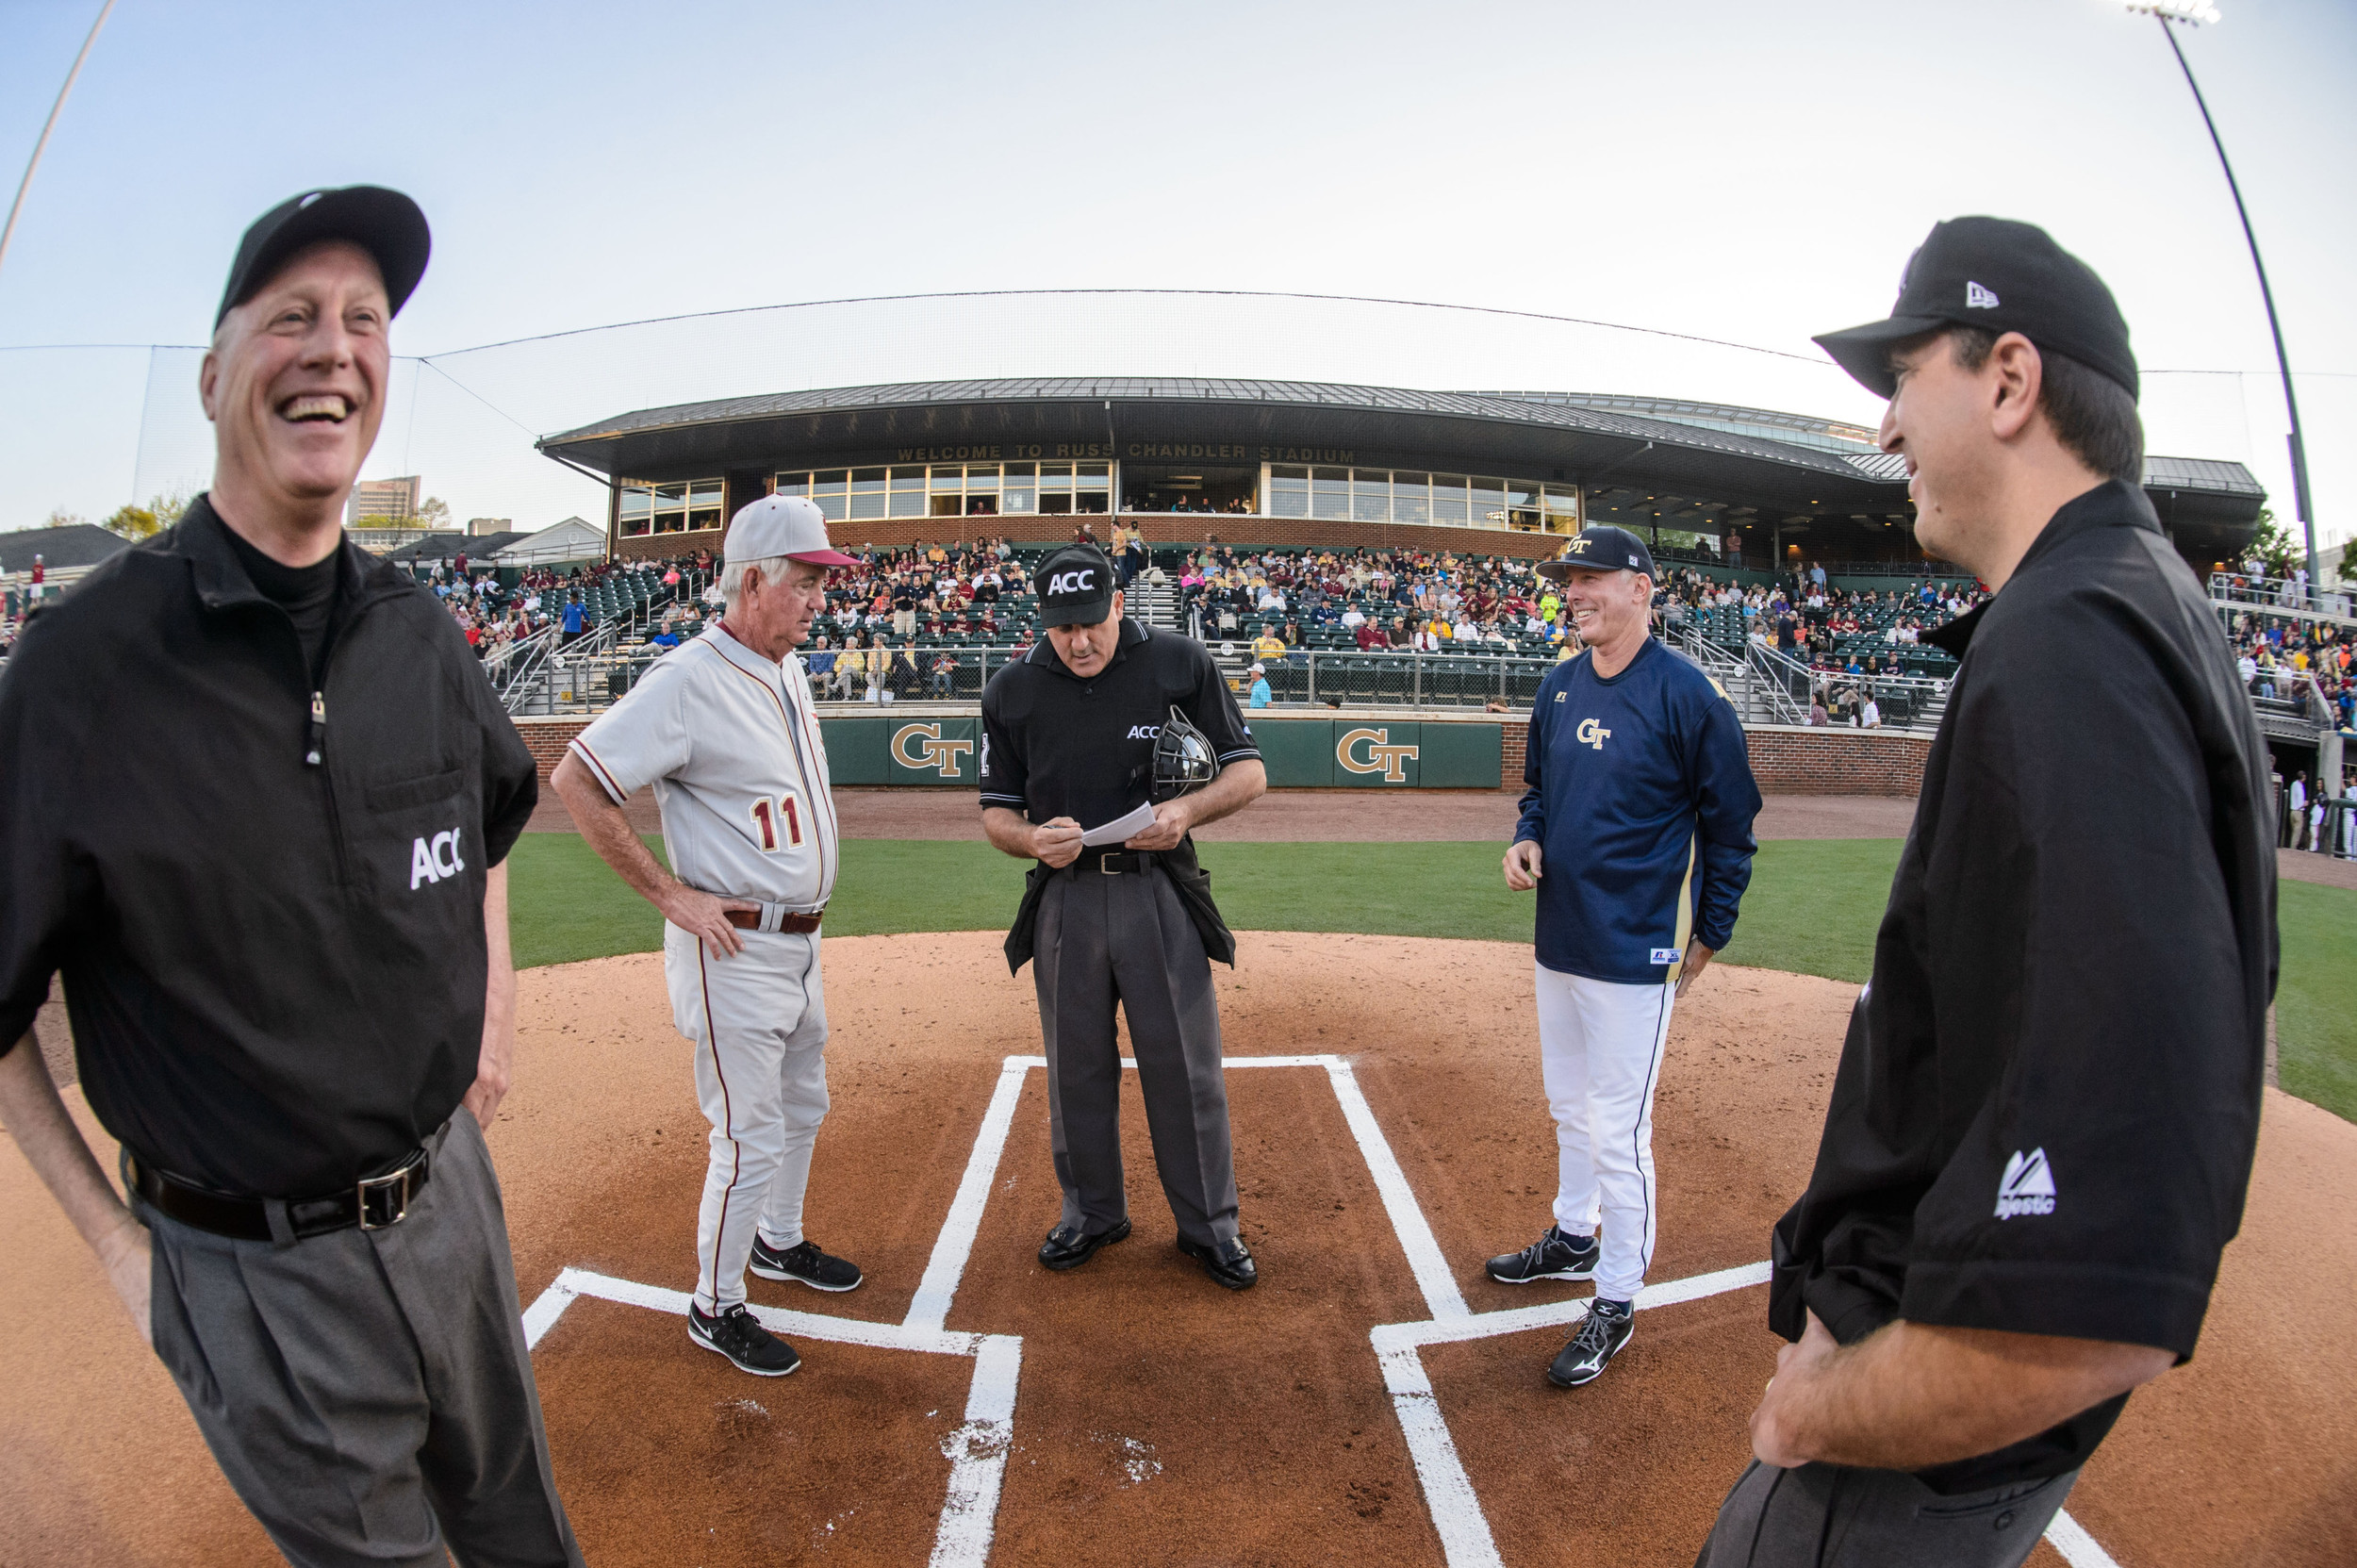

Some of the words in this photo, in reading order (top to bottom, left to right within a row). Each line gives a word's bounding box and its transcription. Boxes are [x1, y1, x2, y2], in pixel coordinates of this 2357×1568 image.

[898, 445, 1001, 461] WELCOME
[1015, 444, 1043, 458] TO
[1057, 443, 1114, 457] RUSS
[1129, 443, 1245, 458] CHANDLER
[1260, 446, 1354, 463] STADIUM
[1047, 569, 1095, 596] ACC
[1127, 725, 1161, 739] ACC
[1576, 718, 1611, 750] GT
[891, 722, 973, 777] GT
[1336, 728, 1419, 782] GT
[749, 791, 806, 853] 11
